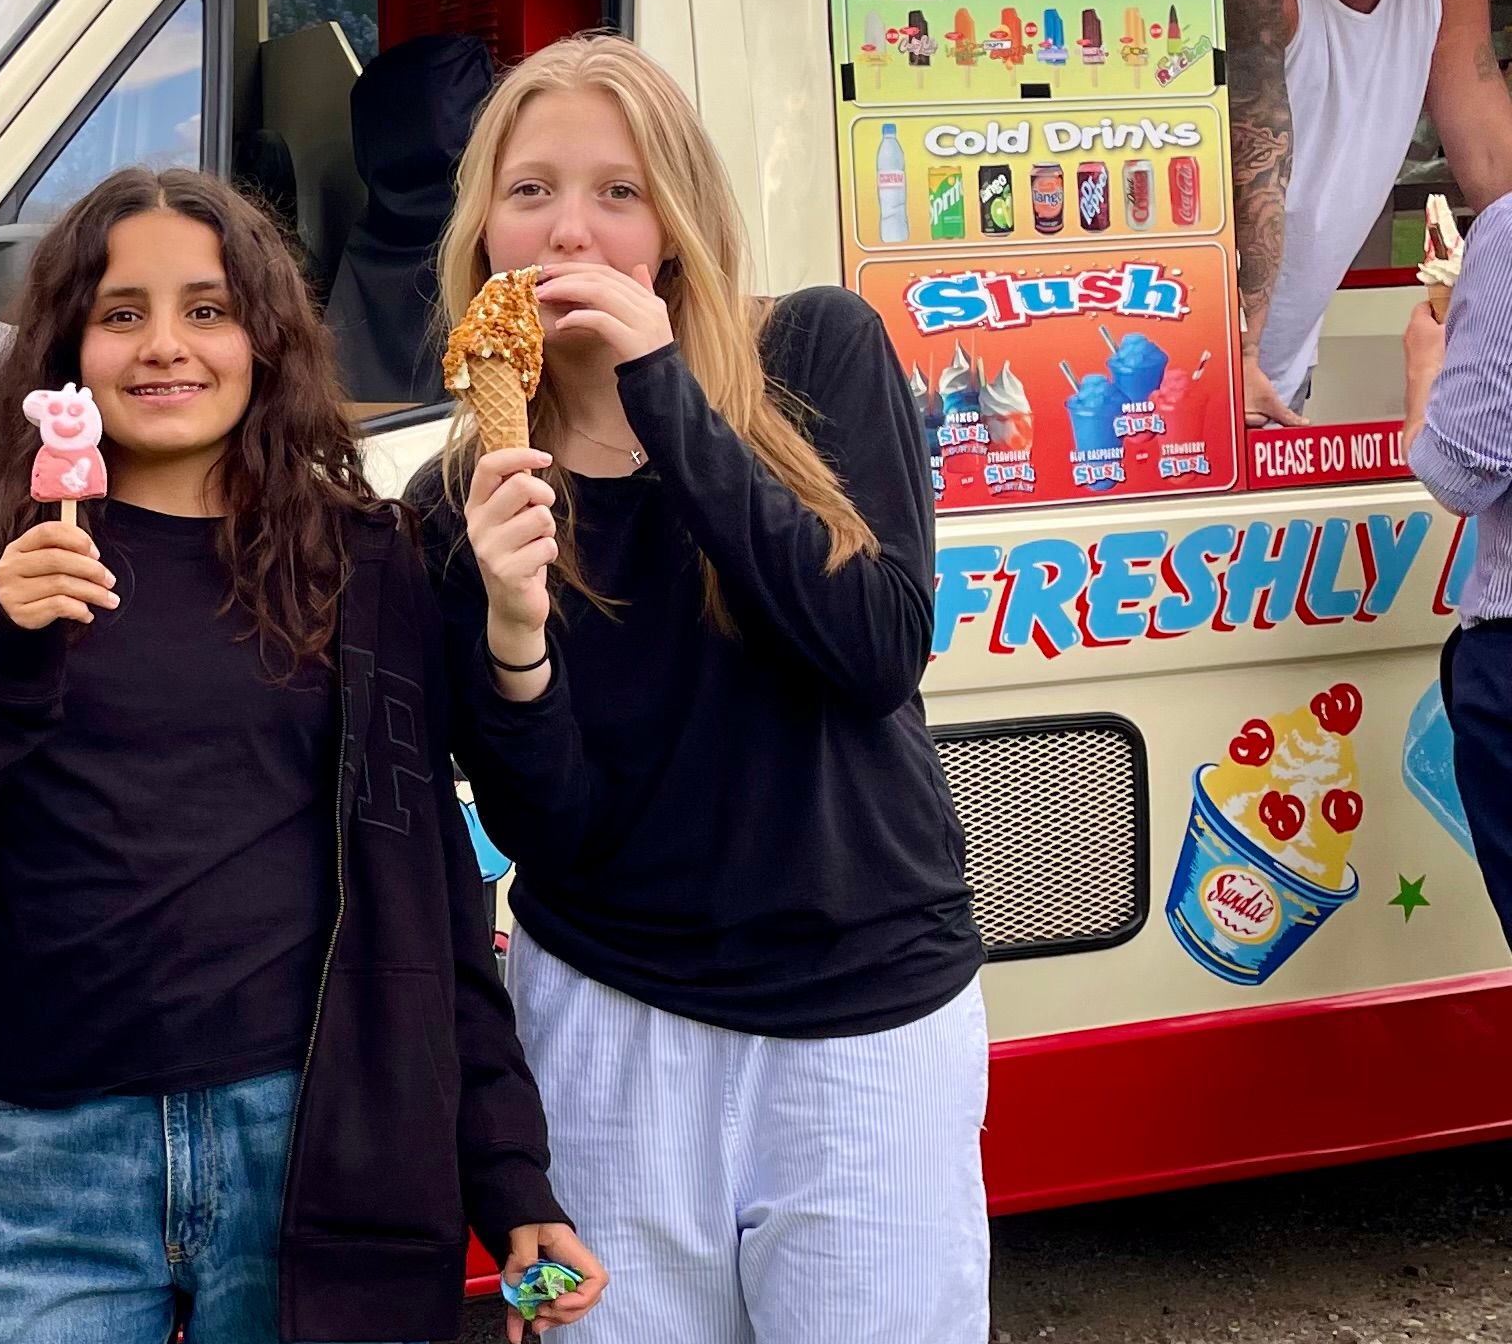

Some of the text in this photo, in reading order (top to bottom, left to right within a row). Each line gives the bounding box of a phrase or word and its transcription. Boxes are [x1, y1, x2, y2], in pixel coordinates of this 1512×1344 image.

[925, 118, 1202, 156] Cold Drinks
[912, 265, 1184, 332] Slush
[947, 411, 979, 424] MIXED
[1121, 401, 1155, 413] MIXED
[938, 424, 989, 446] Slush
[1114, 414, 1165, 437] Slush
[1158, 454, 1210, 478] Slush
[1255, 437, 1315, 478] PLEASE
[1320, 435, 1345, 472] DO
[1351, 433, 1383, 469] NOT
[984, 463, 1035, 485] Slush
[1073, 462, 1125, 485] Slush
[930, 512, 1433, 660] FRESHLY
[1208, 874, 1274, 923] Sundae
